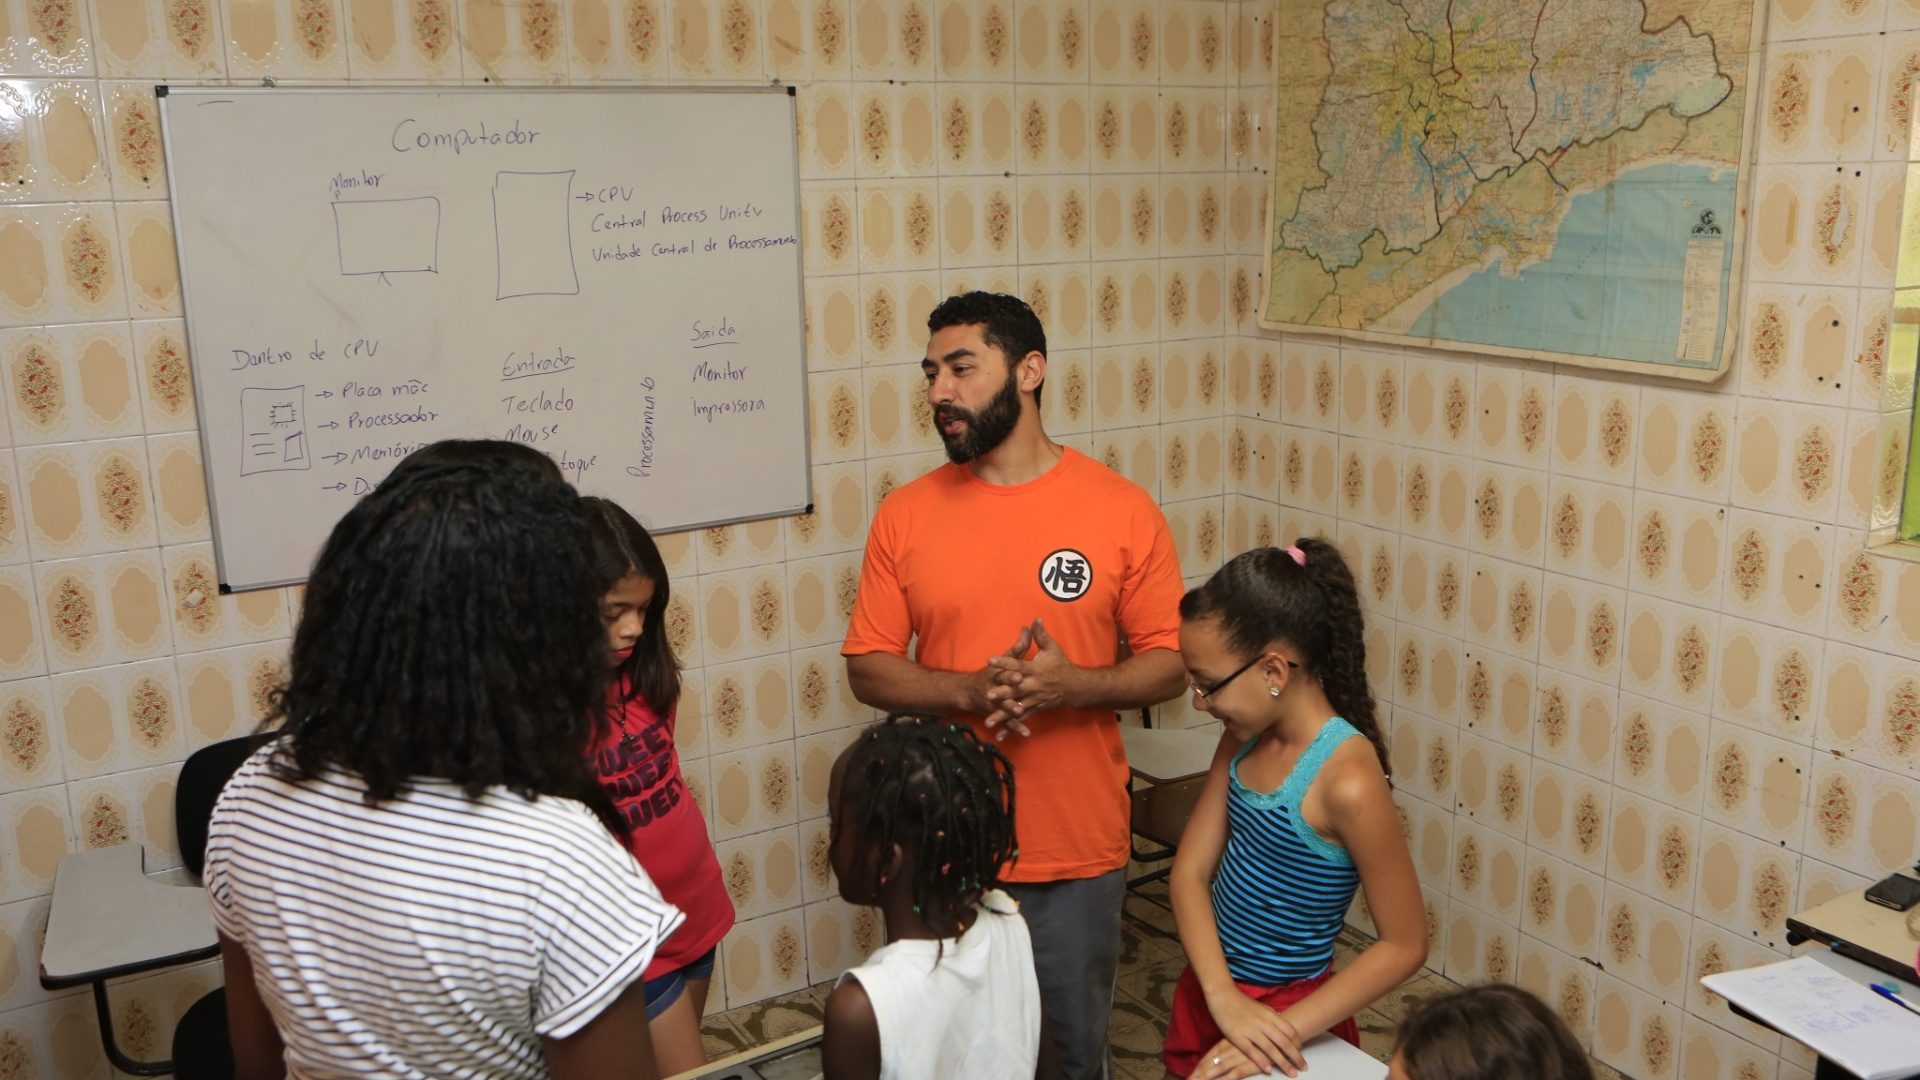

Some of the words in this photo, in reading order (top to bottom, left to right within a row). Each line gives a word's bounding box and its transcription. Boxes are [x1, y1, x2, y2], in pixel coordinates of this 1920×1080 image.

[391, 118, 540, 155] Computador
[328, 170, 385, 192] Monitor
[590, 210, 646, 233] Central
[661, 206, 708, 225] Process
[592, 243, 642, 262] Unidade
[651, 239, 695, 257] Central
[704, 237, 717, 252] de
[309, 339, 326, 361] de
[502, 347, 576, 377] Entrada
[692, 361, 748, 383] Monitor
[342, 381, 383, 398] Placa
[501, 388, 574, 413] Teclado
[348, 405, 439, 429] Processador
[504, 423, 559, 444] Mouse
[560, 450, 597, 483] toque
[353, 476, 381, 496] Dis
[1045, 556, 1087, 594] 悟
